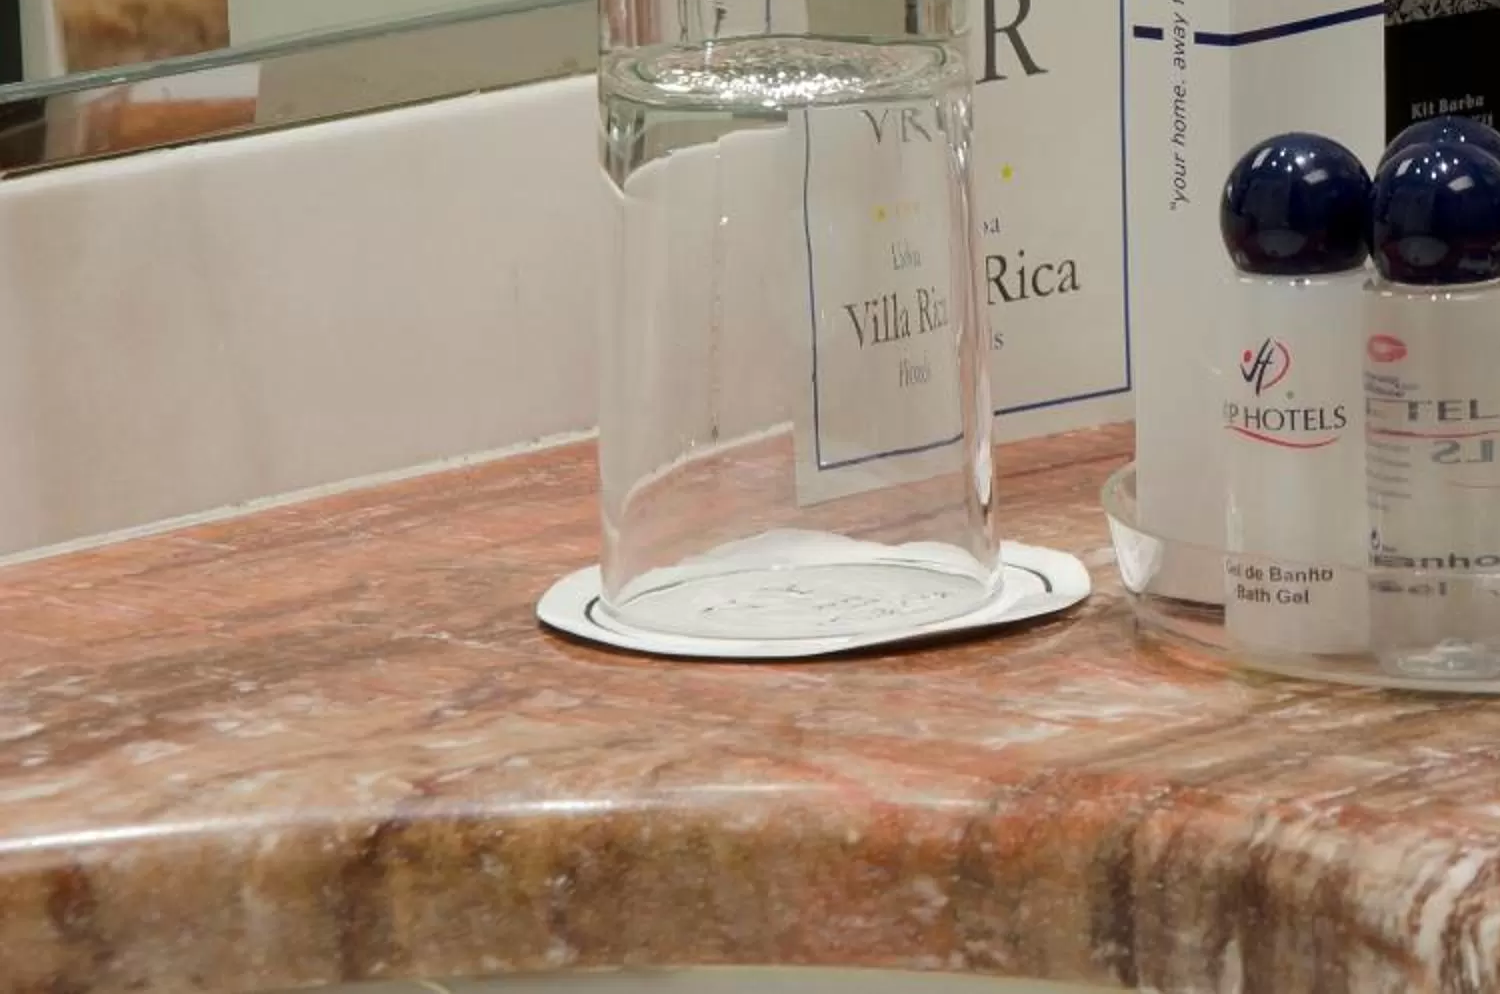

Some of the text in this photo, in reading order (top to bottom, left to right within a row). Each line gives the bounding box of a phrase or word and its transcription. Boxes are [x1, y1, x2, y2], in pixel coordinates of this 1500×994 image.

[1172, 11, 1191, 71] away
[1411, 93, 1485, 120] Kit Barba
[985, 249, 1081, 306] Rica
[843, 292, 911, 350] Villa
[1243, 404, 1348, 432] HOTELS
[1245, 565, 1264, 582] de
[1269, 565, 1334, 584] Banho
[1237, 582, 1310, 605] Bath Gel
